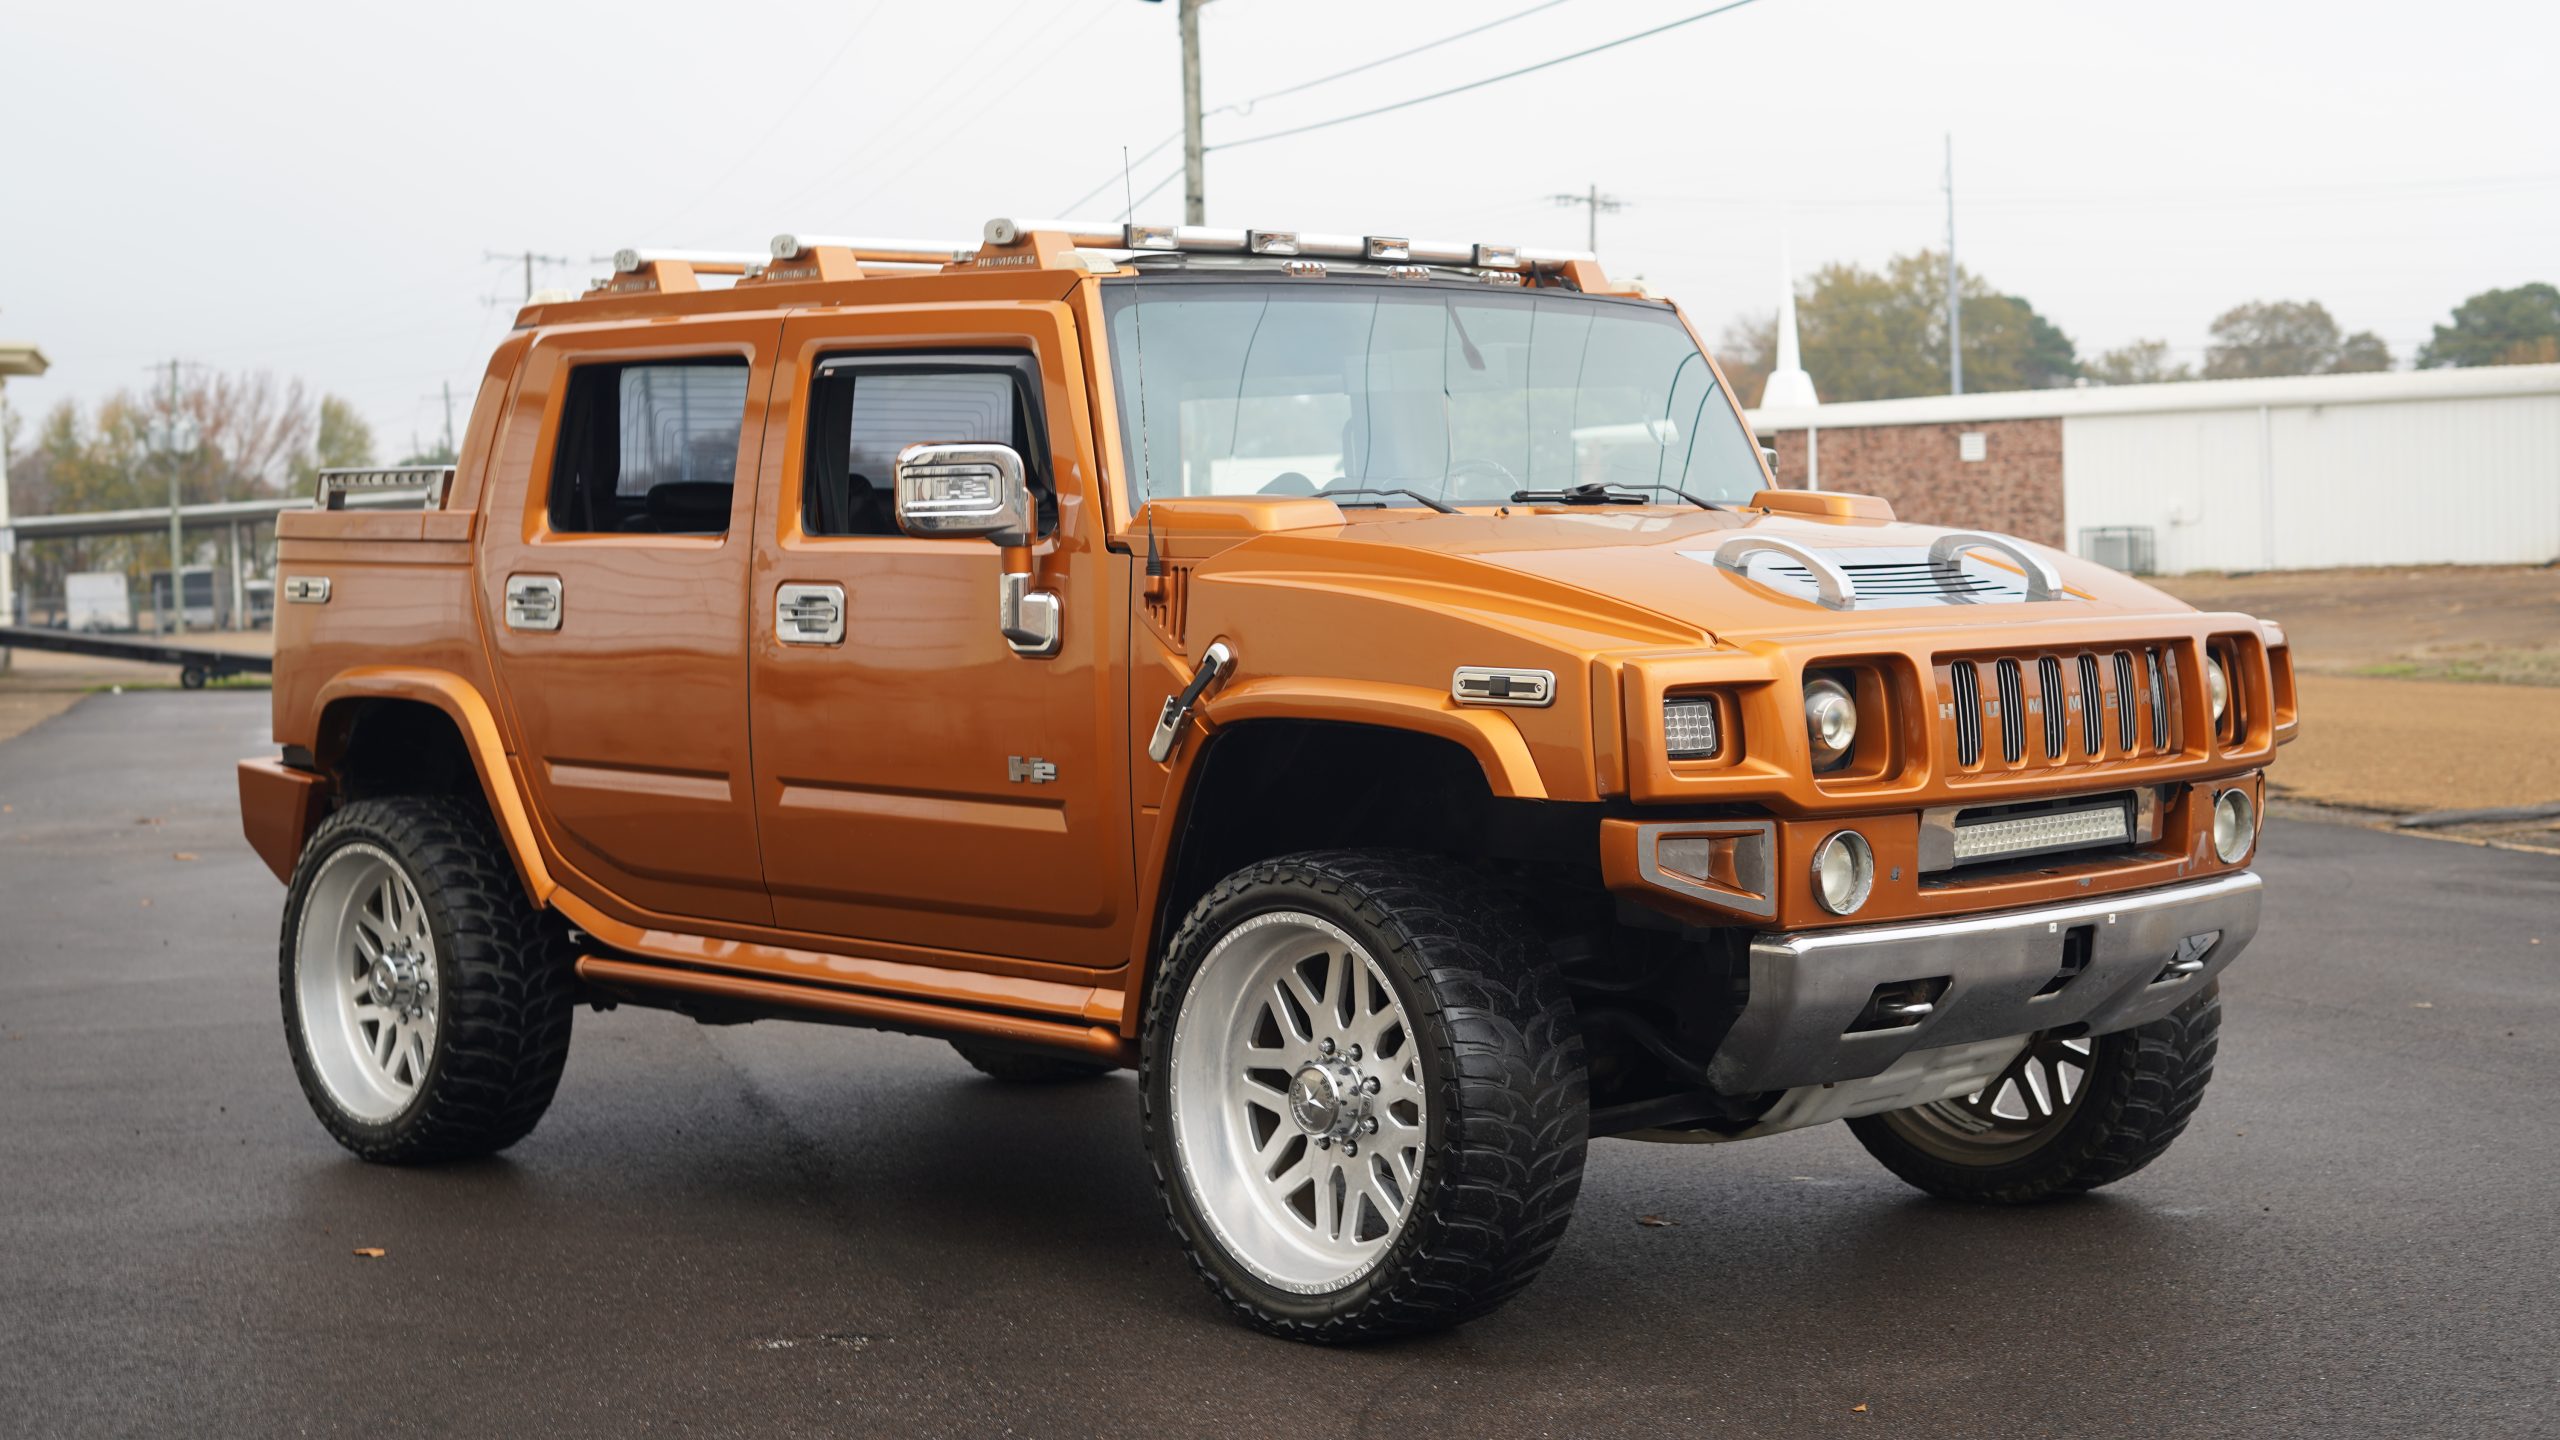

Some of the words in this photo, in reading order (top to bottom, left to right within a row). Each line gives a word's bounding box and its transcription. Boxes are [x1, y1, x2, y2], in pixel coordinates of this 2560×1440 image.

[976, 254, 1035, 267] HUMMER
[1938, 687, 2151, 721] HUMMER
[1008, 755, 1056, 784] H2
